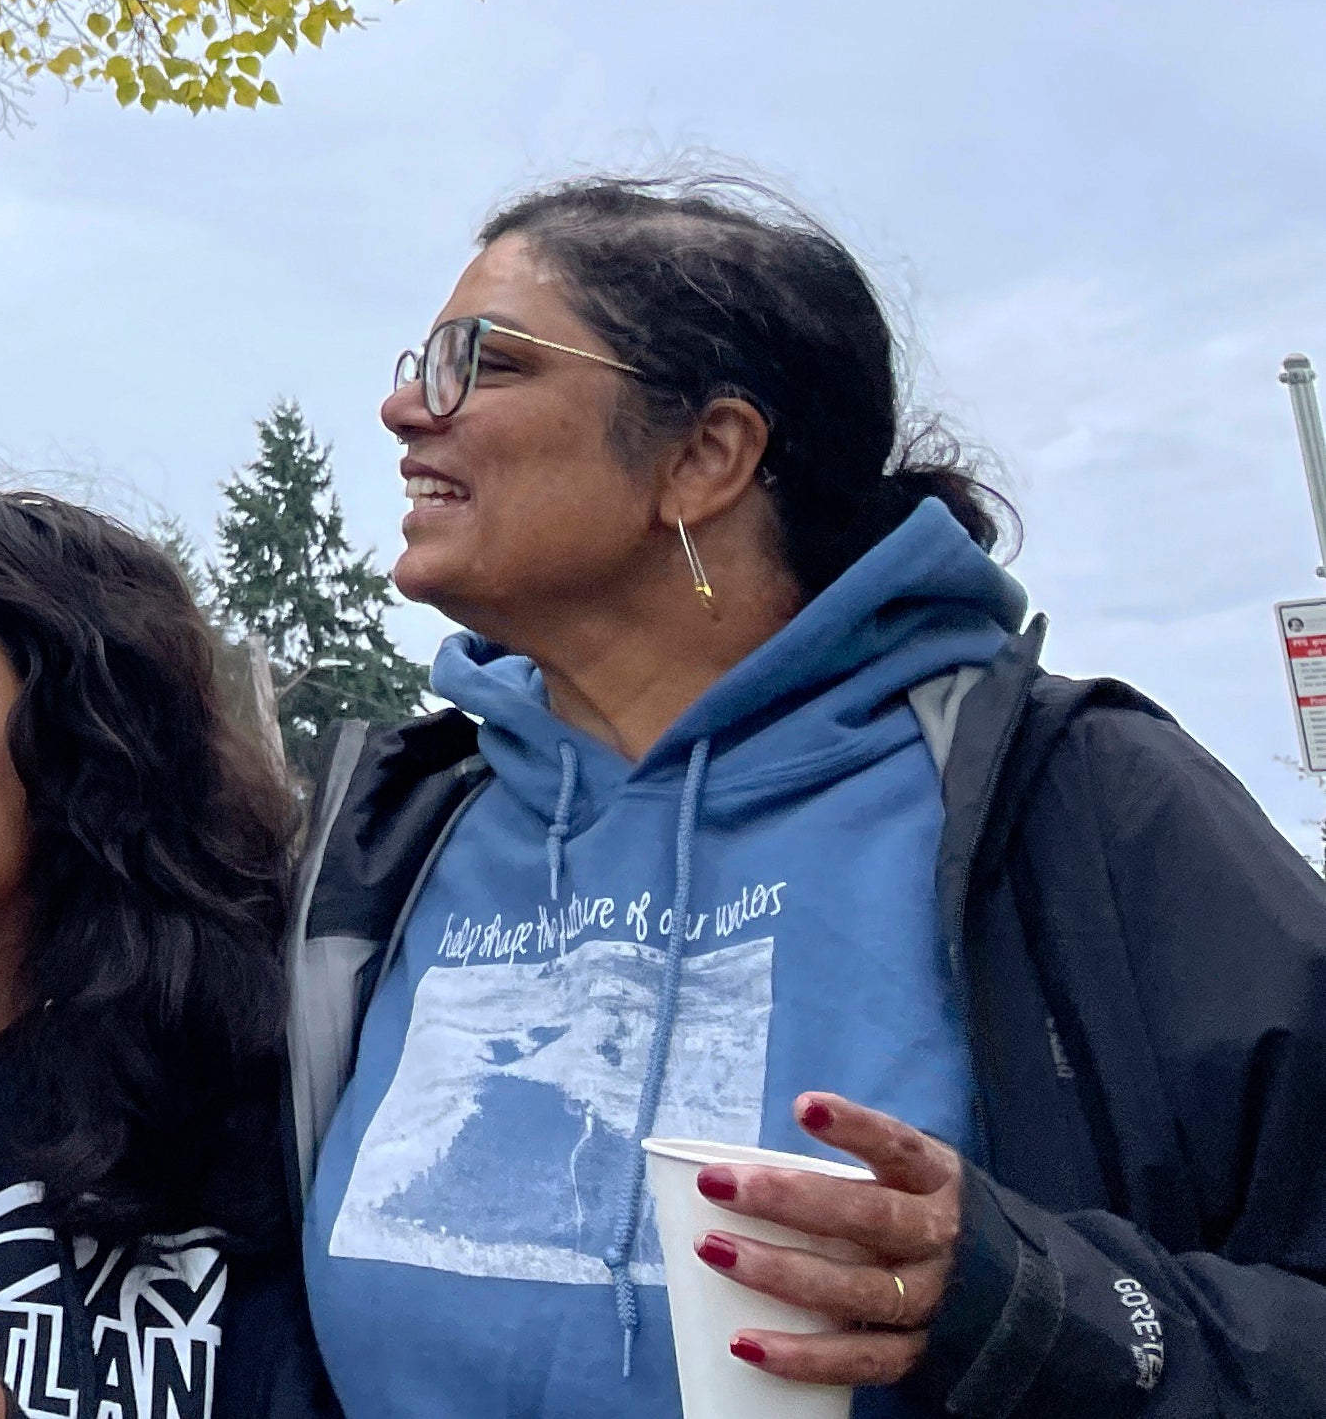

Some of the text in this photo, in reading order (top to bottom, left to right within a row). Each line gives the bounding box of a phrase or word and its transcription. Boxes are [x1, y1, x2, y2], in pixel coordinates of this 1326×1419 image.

[477, 913, 534, 969] shape
[557, 890, 615, 959] future
[626, 891, 651, 942] of
[715, 881, 787, 938] waters
